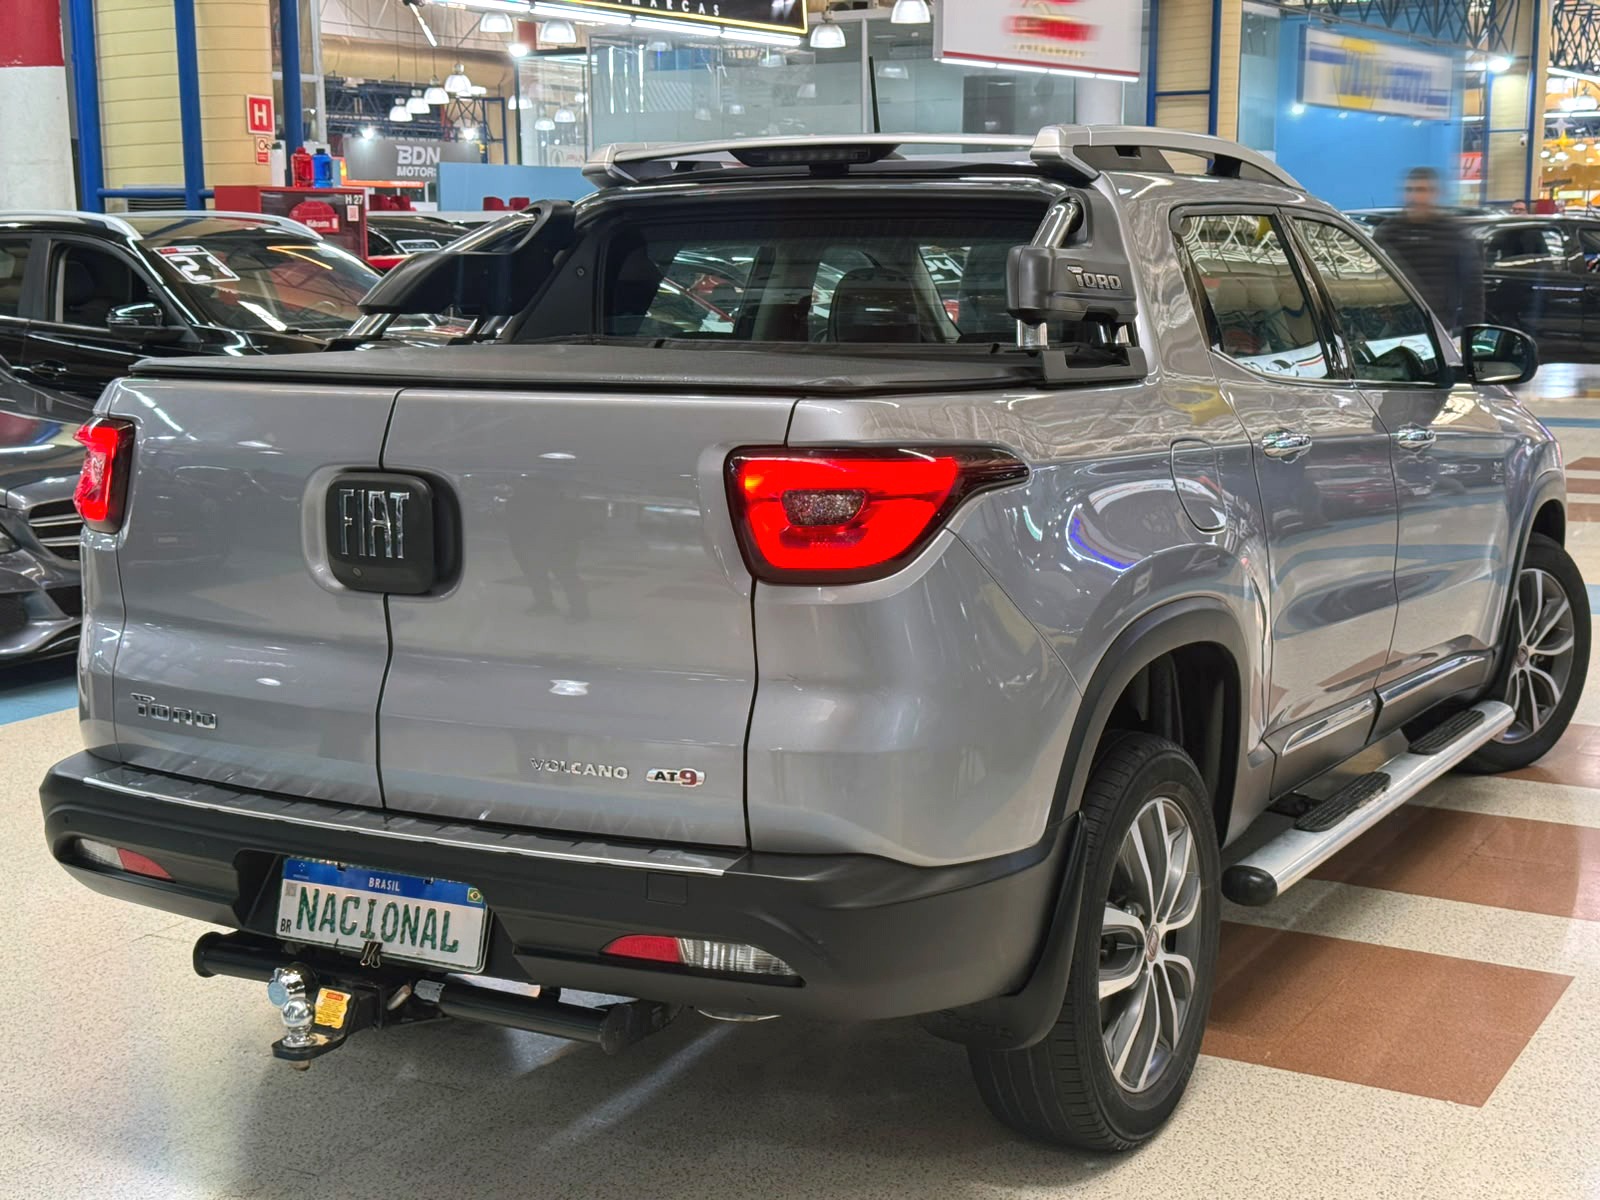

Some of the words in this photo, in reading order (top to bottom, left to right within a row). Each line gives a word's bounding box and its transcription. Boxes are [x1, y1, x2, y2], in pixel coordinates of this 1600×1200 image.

[617, 0, 720, 16] ARCAS
[253, 103, 268, 127] H
[395, 144, 441, 166] BDN
[353, 194, 364, 205] 27
[168, 255, 234, 282] 21
[1066, 264, 1123, 290] TORO
[338, 488, 410, 559] FIAT
[130, 692, 217, 730] TORO
[530, 757, 629, 780] VOLCANO
[653, 767, 699, 787] AT9
[368, 876, 401, 893] BRASIL
[279, 917, 292, 934] BR
[296, 885, 459, 953] NACIONAL
